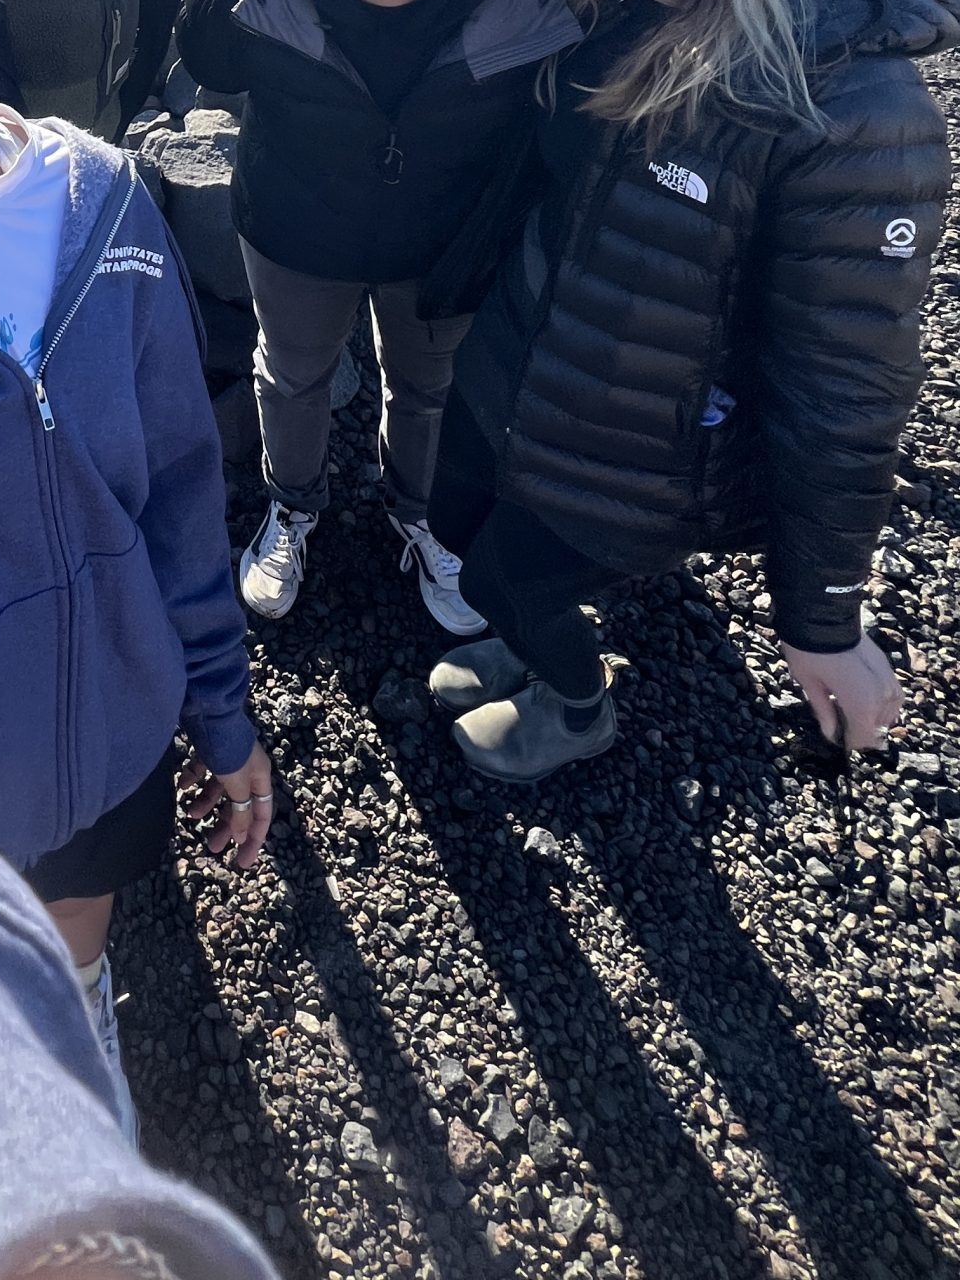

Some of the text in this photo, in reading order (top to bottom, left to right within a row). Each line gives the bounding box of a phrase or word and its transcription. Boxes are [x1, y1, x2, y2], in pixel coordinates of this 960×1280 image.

[648, 161, 687, 187] NORTH
[668, 161, 690, 179] THE
[656, 175, 686, 194] FACE
